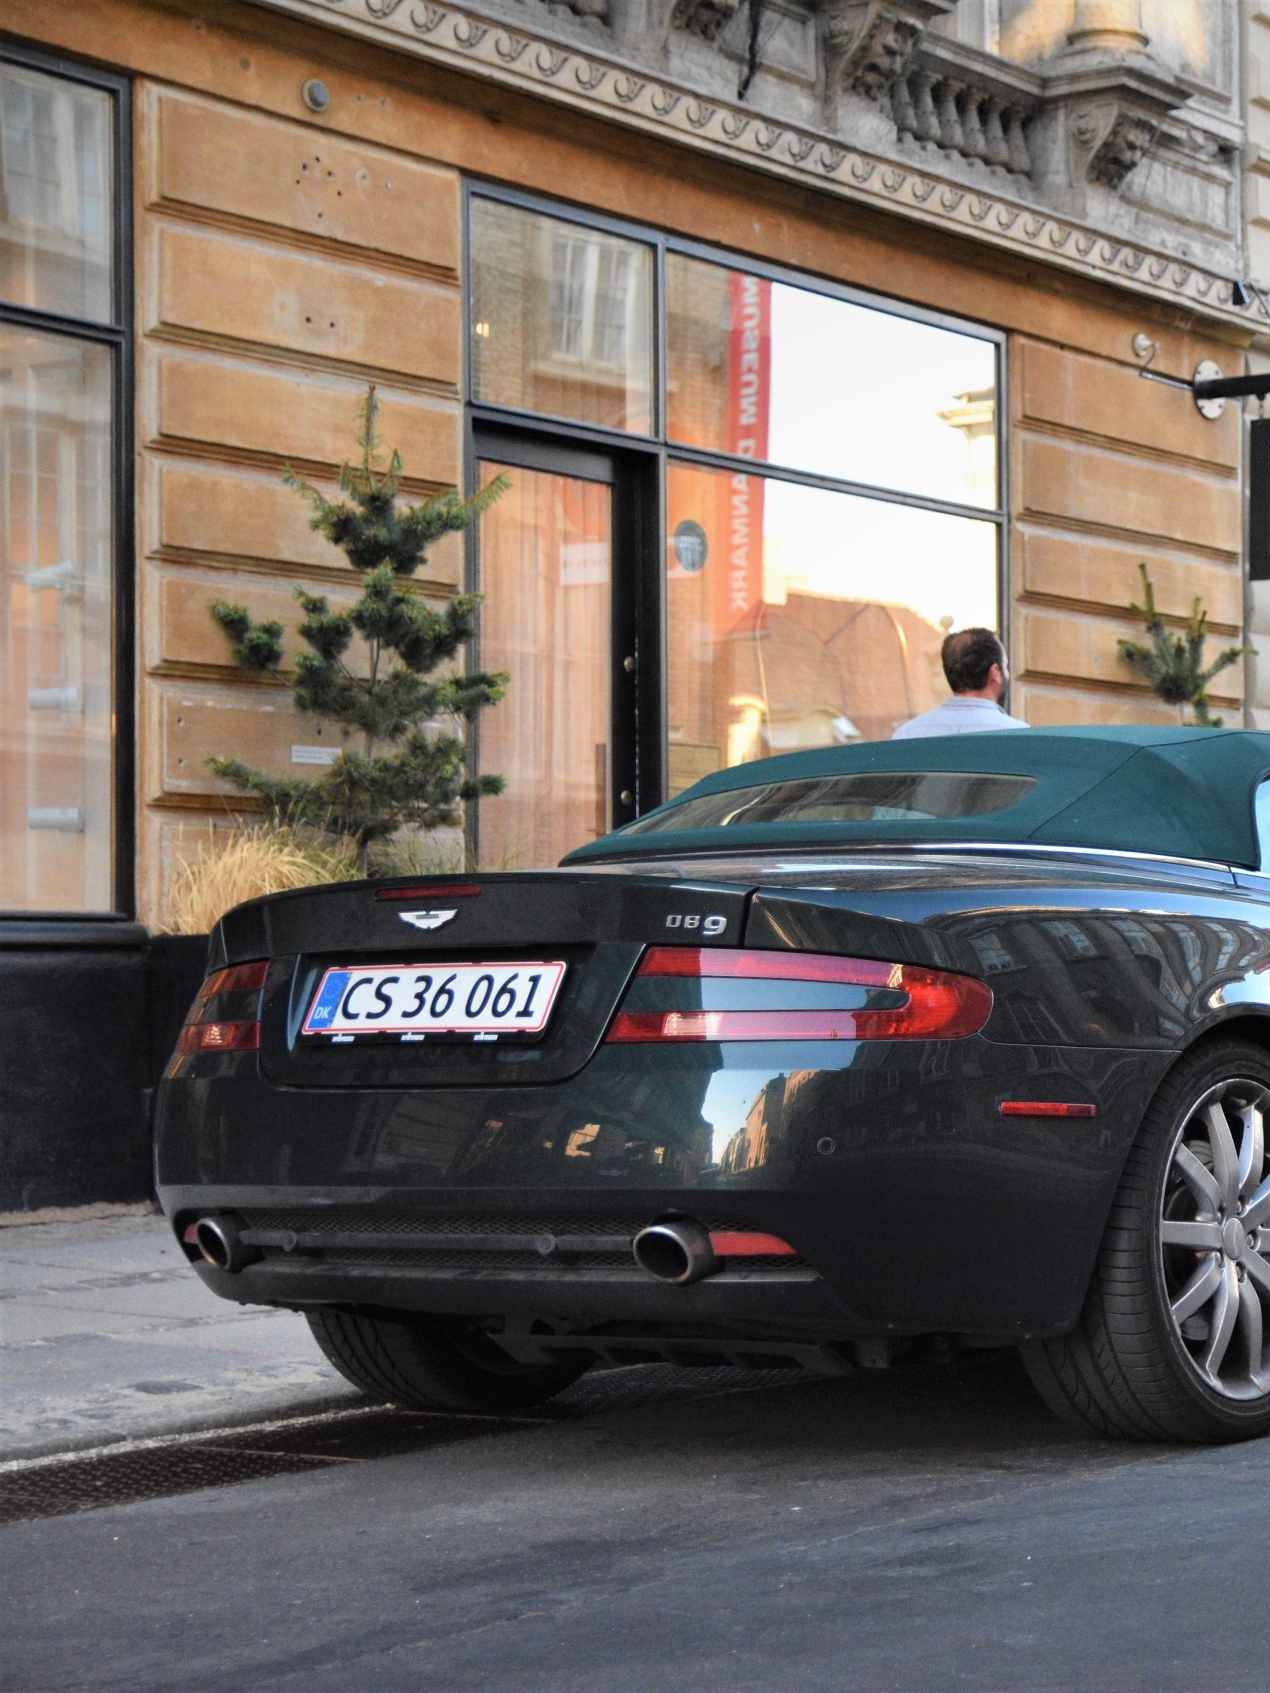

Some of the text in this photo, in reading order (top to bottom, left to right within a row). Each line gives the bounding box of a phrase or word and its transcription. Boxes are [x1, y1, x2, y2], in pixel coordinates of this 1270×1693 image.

[665, 915, 727, 935] DB9
[341, 972, 542, 1020] CS 36 061
[313, 1006, 332, 1020] DK
